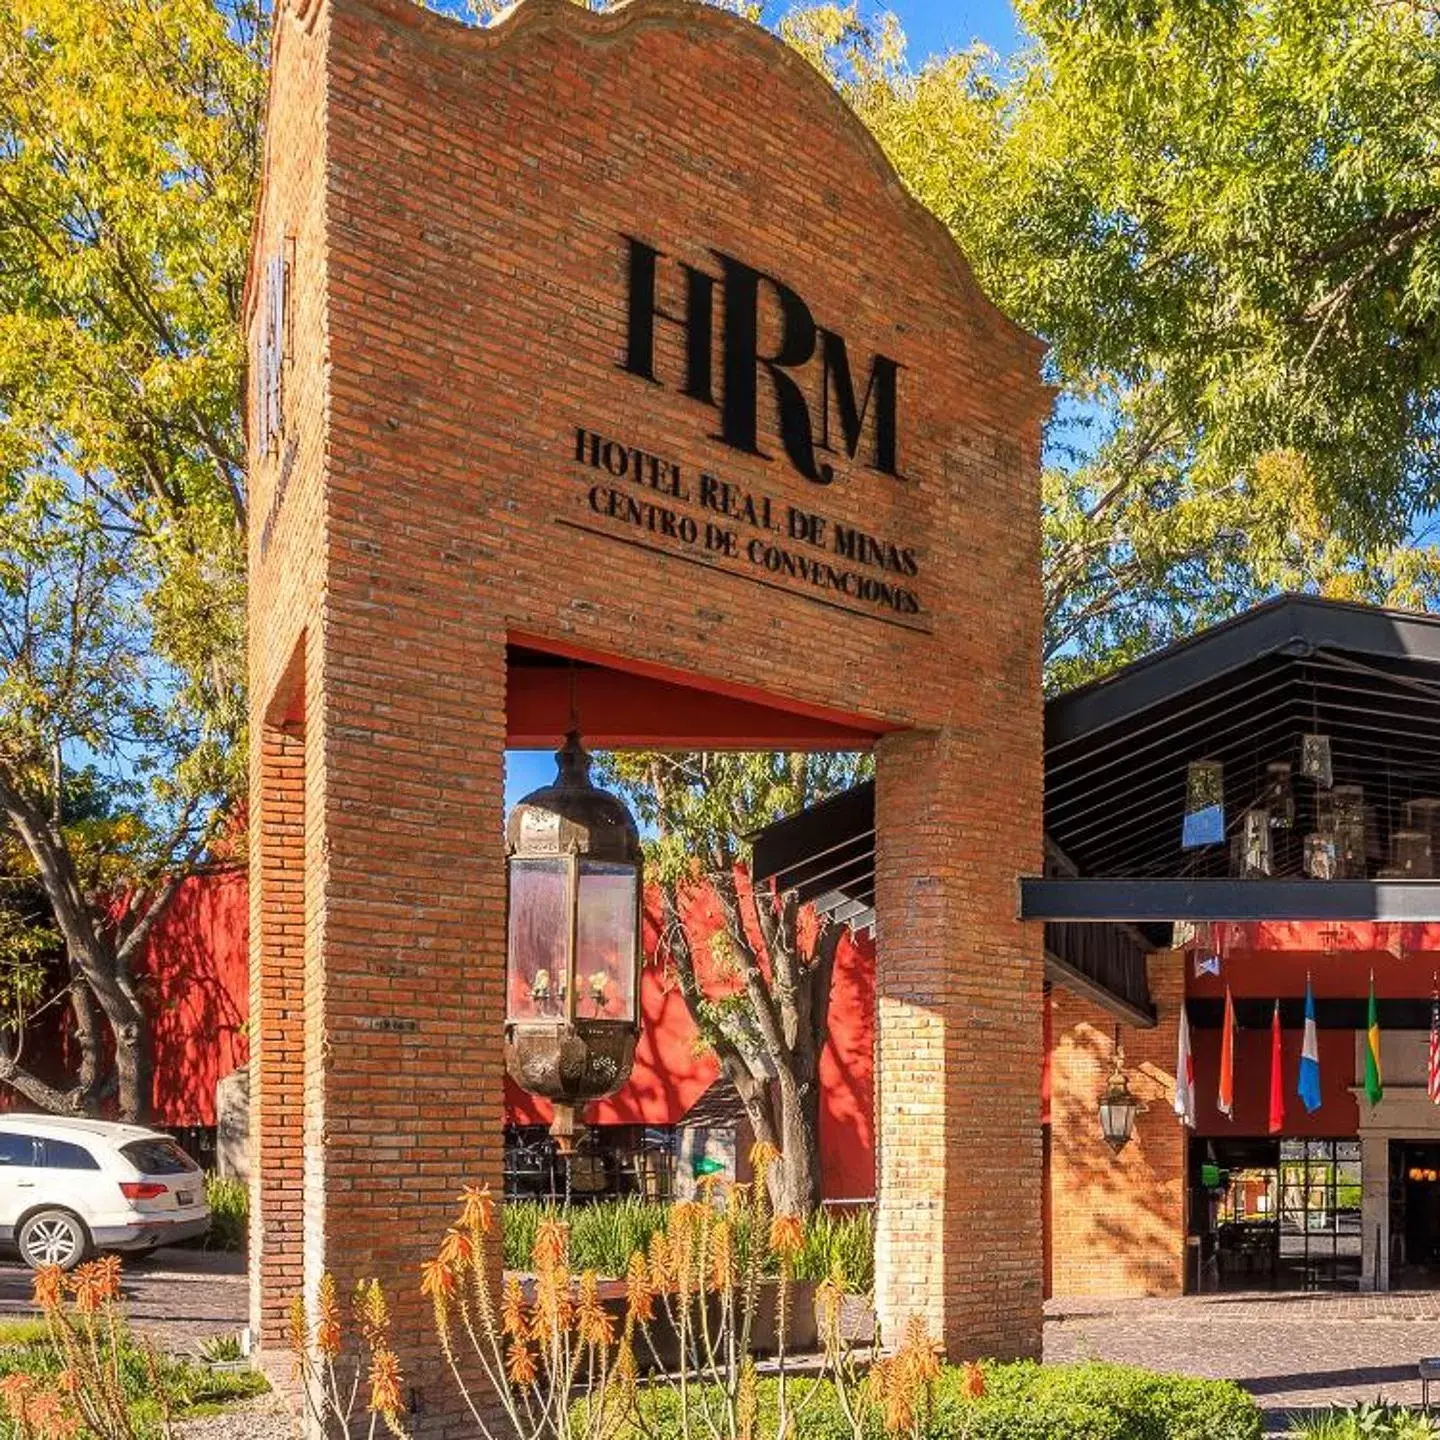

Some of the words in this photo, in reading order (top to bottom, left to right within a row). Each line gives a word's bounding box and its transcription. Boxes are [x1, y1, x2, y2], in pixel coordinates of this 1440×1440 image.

[615, 232, 908, 484] HRM
[574, 427, 690, 501] HOTEL
[700, 472, 780, 532] REAL
[787, 508, 827, 547] DE
[834, 524, 919, 577] MINAS
[588, 486, 698, 544] CENTRO
[705, 524, 738, 559] DE
[747, 540, 920, 614] CONVENCIONES
